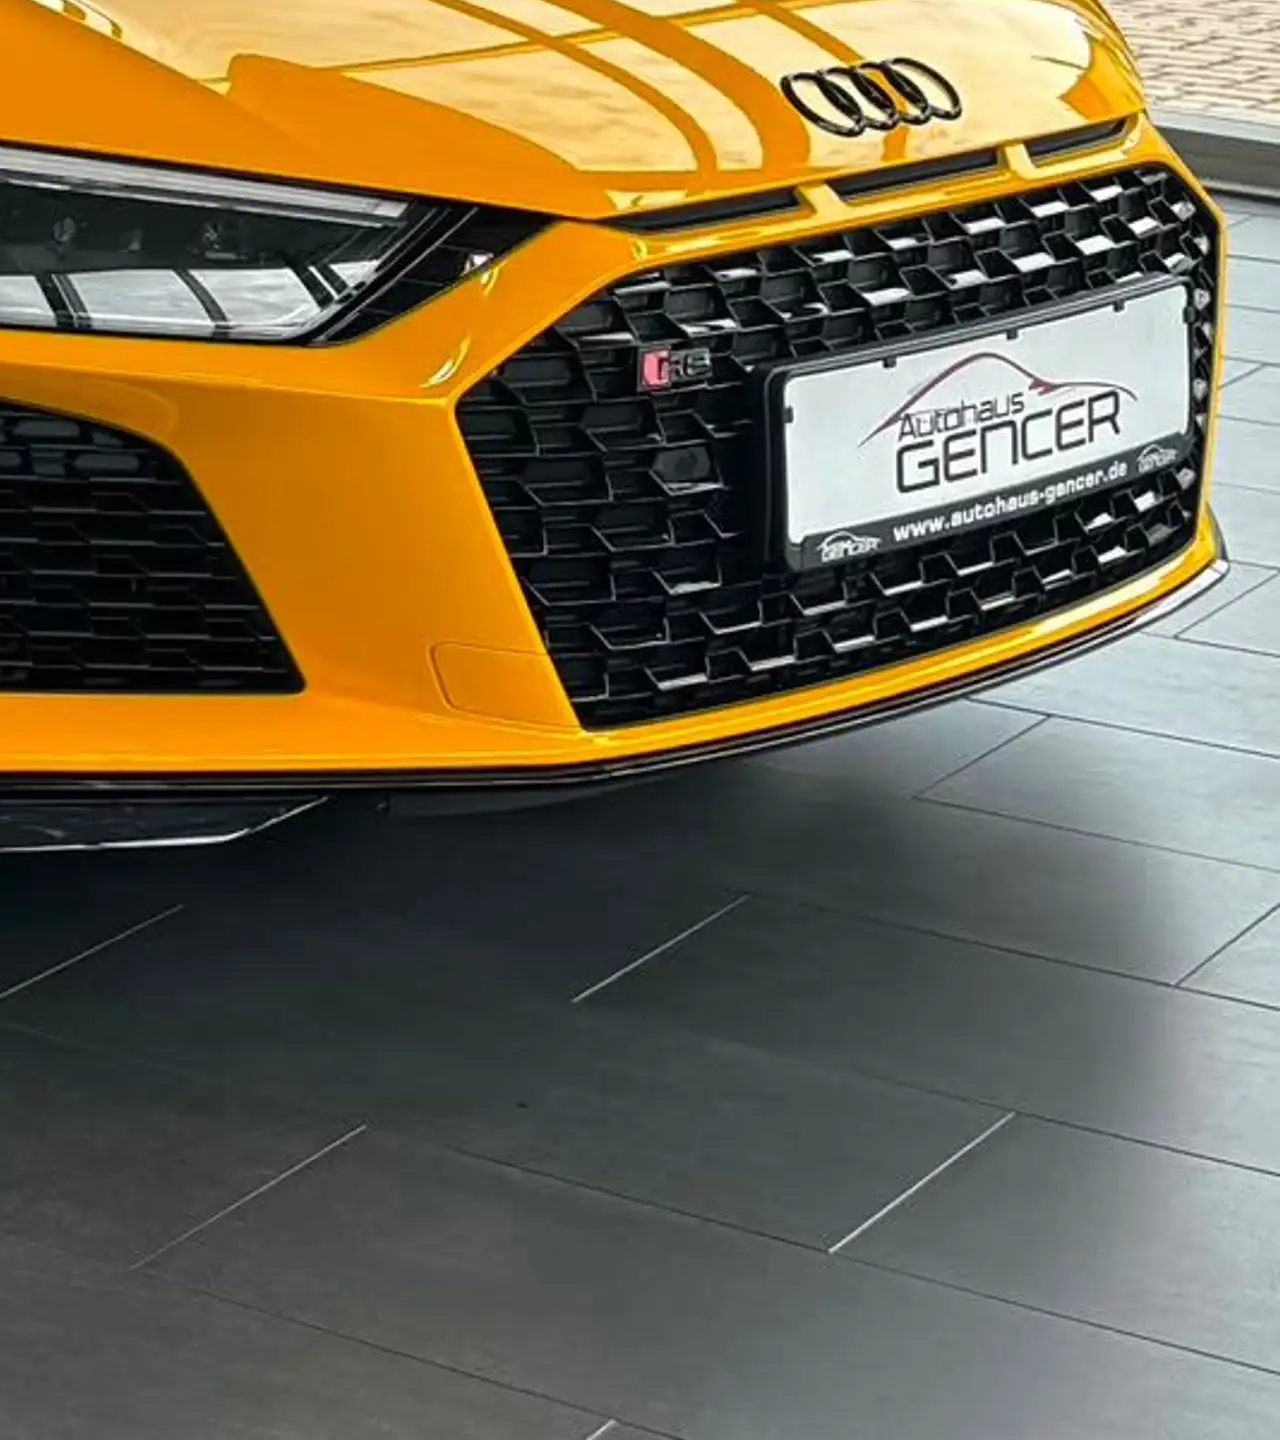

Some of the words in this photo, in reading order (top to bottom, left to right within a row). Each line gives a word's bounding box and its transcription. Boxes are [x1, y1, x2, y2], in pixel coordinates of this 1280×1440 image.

[896, 389, 1121, 493] GENCER
[897, 392, 1025, 441] Autohaus
[892, 460, 1128, 542] www.autohaus-gencer.de
